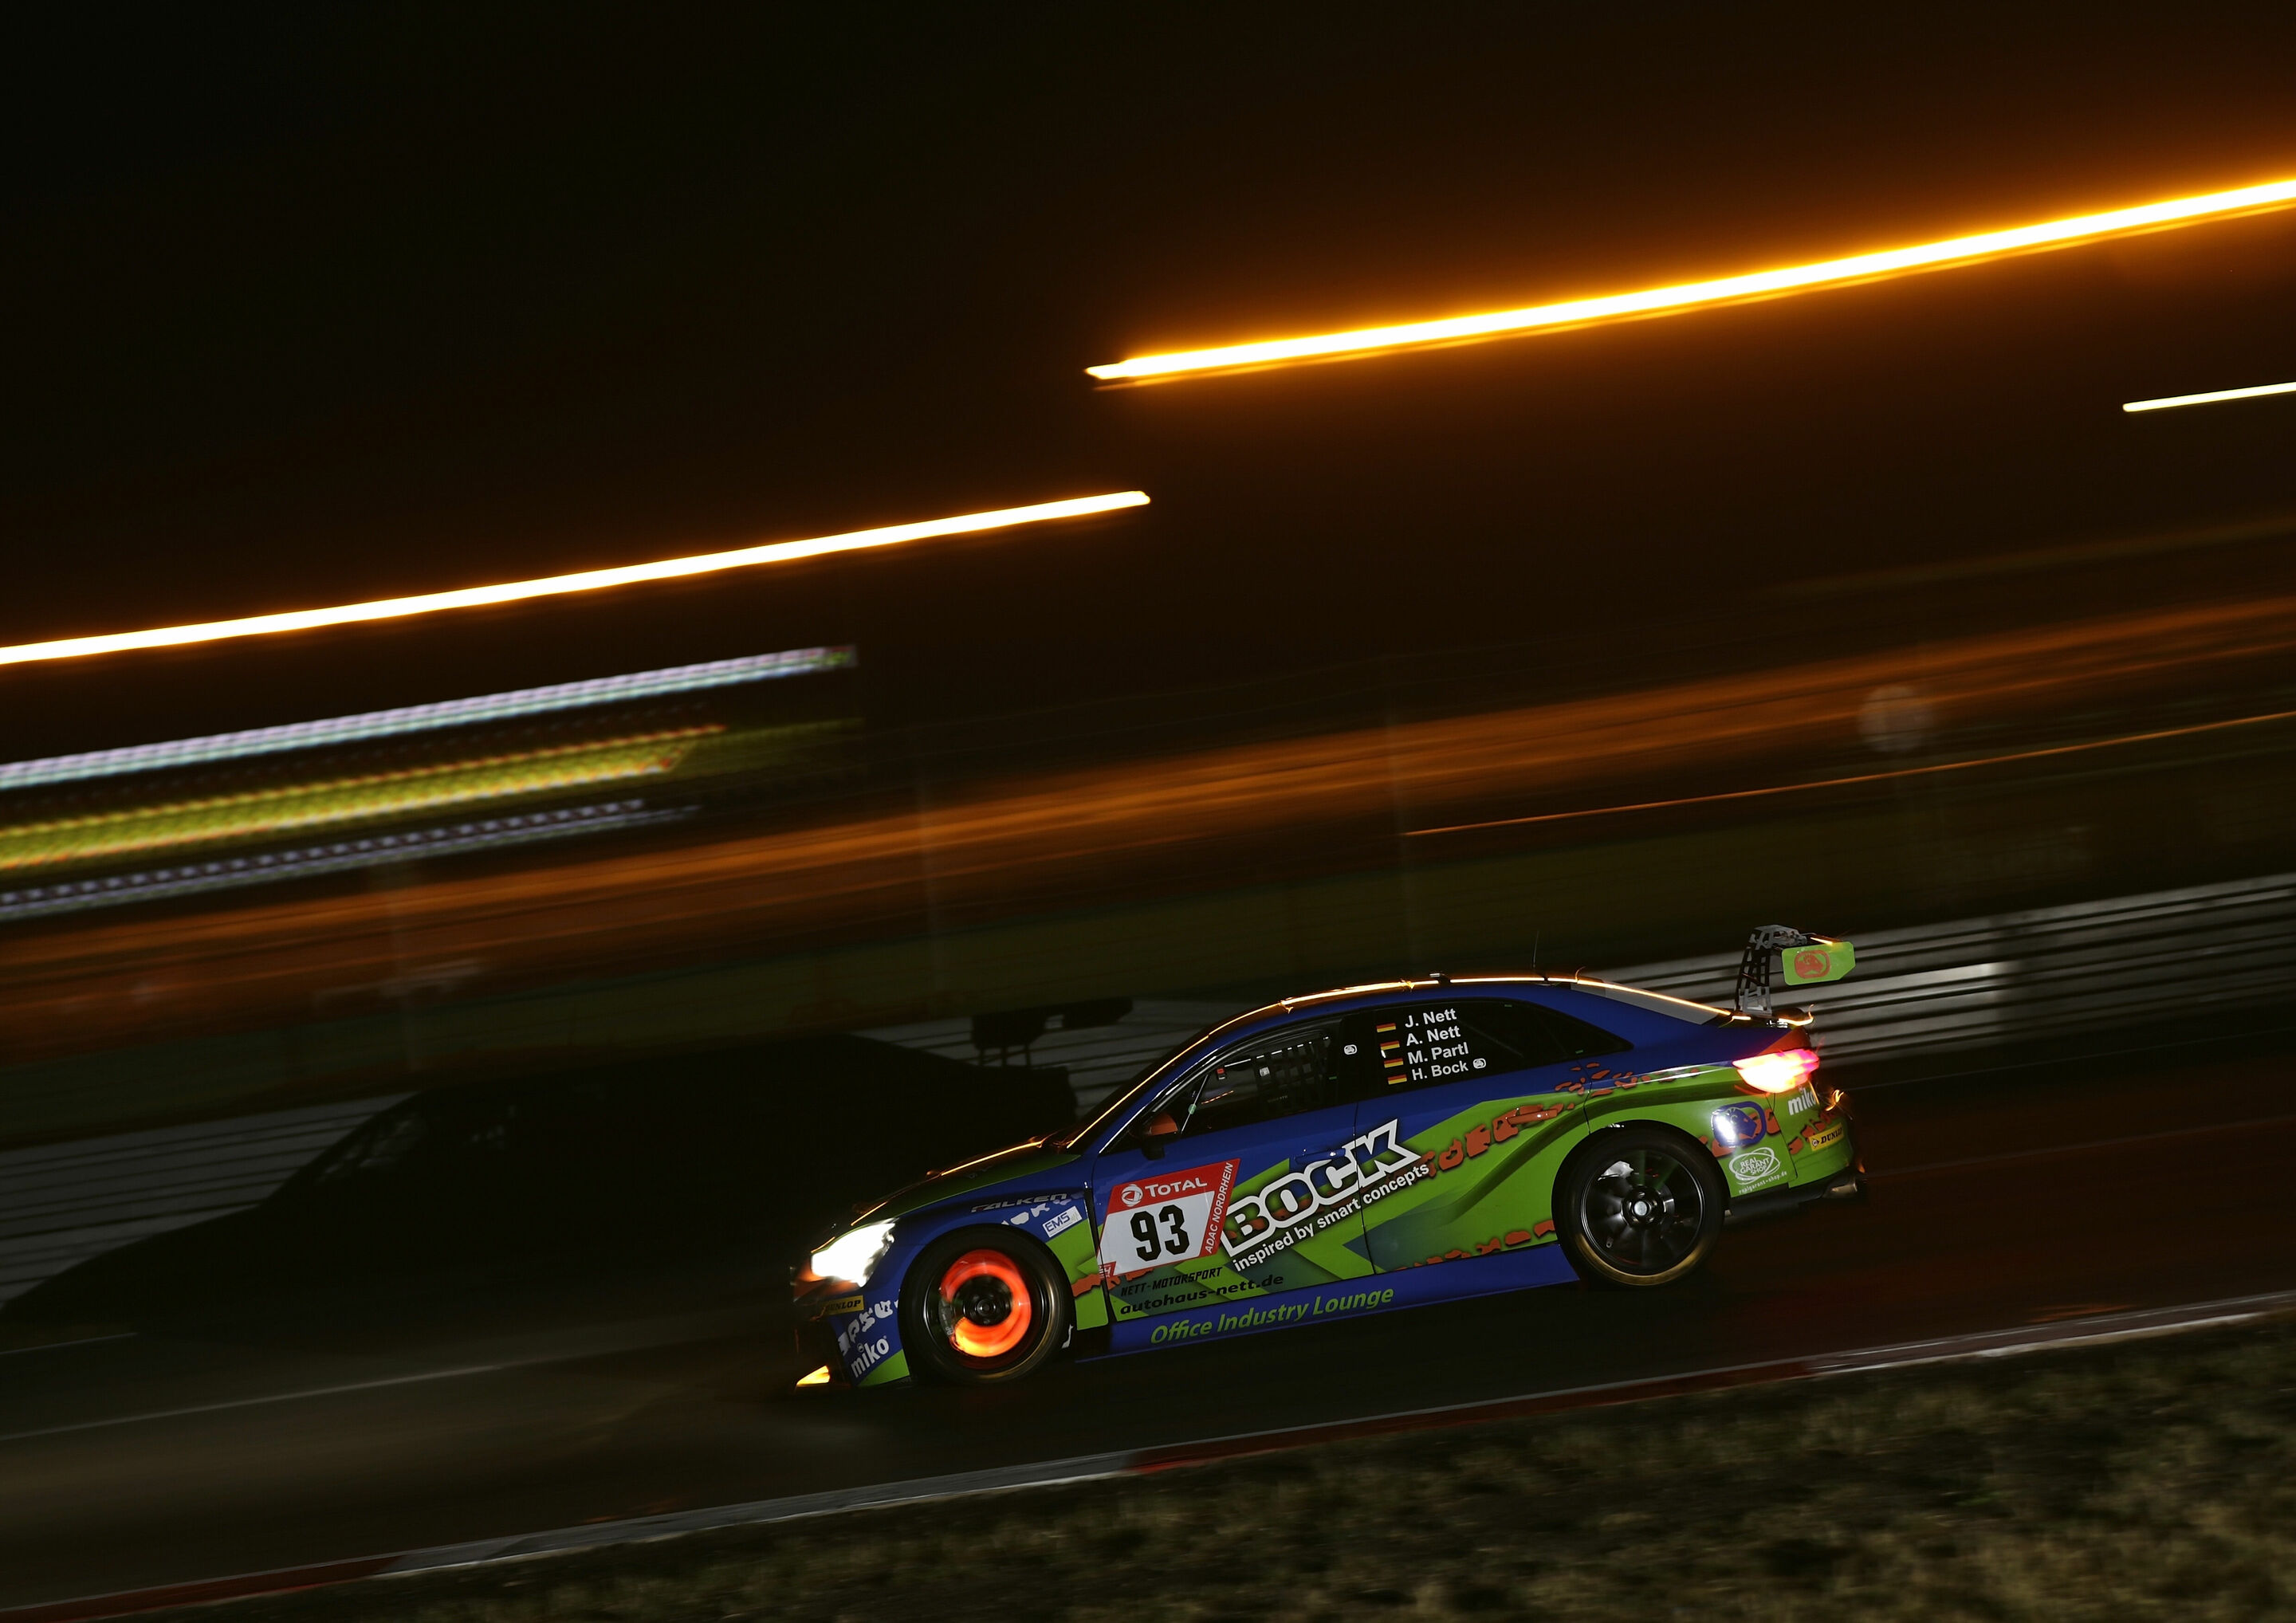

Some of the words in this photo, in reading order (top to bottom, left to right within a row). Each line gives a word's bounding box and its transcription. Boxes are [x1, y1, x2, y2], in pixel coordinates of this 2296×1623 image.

[1405, 1015, 1419, 1028] J.
[1422, 1008, 1457, 1025] Nett
[1406, 1032, 1423, 1047] A.
[1426, 1025, 1461, 1043] Nett
[1407, 1050, 1429, 1065] M.
[1431, 1041, 1469, 1060] Partl
[1411, 1067, 1428, 1081] H.
[1430, 1060, 1469, 1078] Bock
[1740, 1156, 1757, 1167] REAL
[1145, 1177, 1208, 1197] TOTAL
[1220, 1118, 1421, 1258] BOCK
[970, 1193, 1067, 1212] FALKEN
[1205, 1224, 1218, 1254] ADAC
[1212, 1162, 1233, 1223] NORDRHEIN
[1044, 1212, 1070, 1232] EMS
[1233, 1235, 1295, 1272] inspired
[1295, 1224, 1315, 1240] by
[1316, 1197, 1362, 1228] smart
[1362, 1163, 1430, 1205] concepts
[1130, 1204, 1189, 1262] 93
[1120, 1275, 1284, 1315] autohaus-nett.de
[1121, 1267, 1223, 1297] NETT-MOTORSPORT
[1150, 1319, 1213, 1345] Office
[1217, 1303, 1310, 1333] Industry
[1312, 1288, 1394, 1315] Lounge
[851, 1338, 890, 1378] miko
